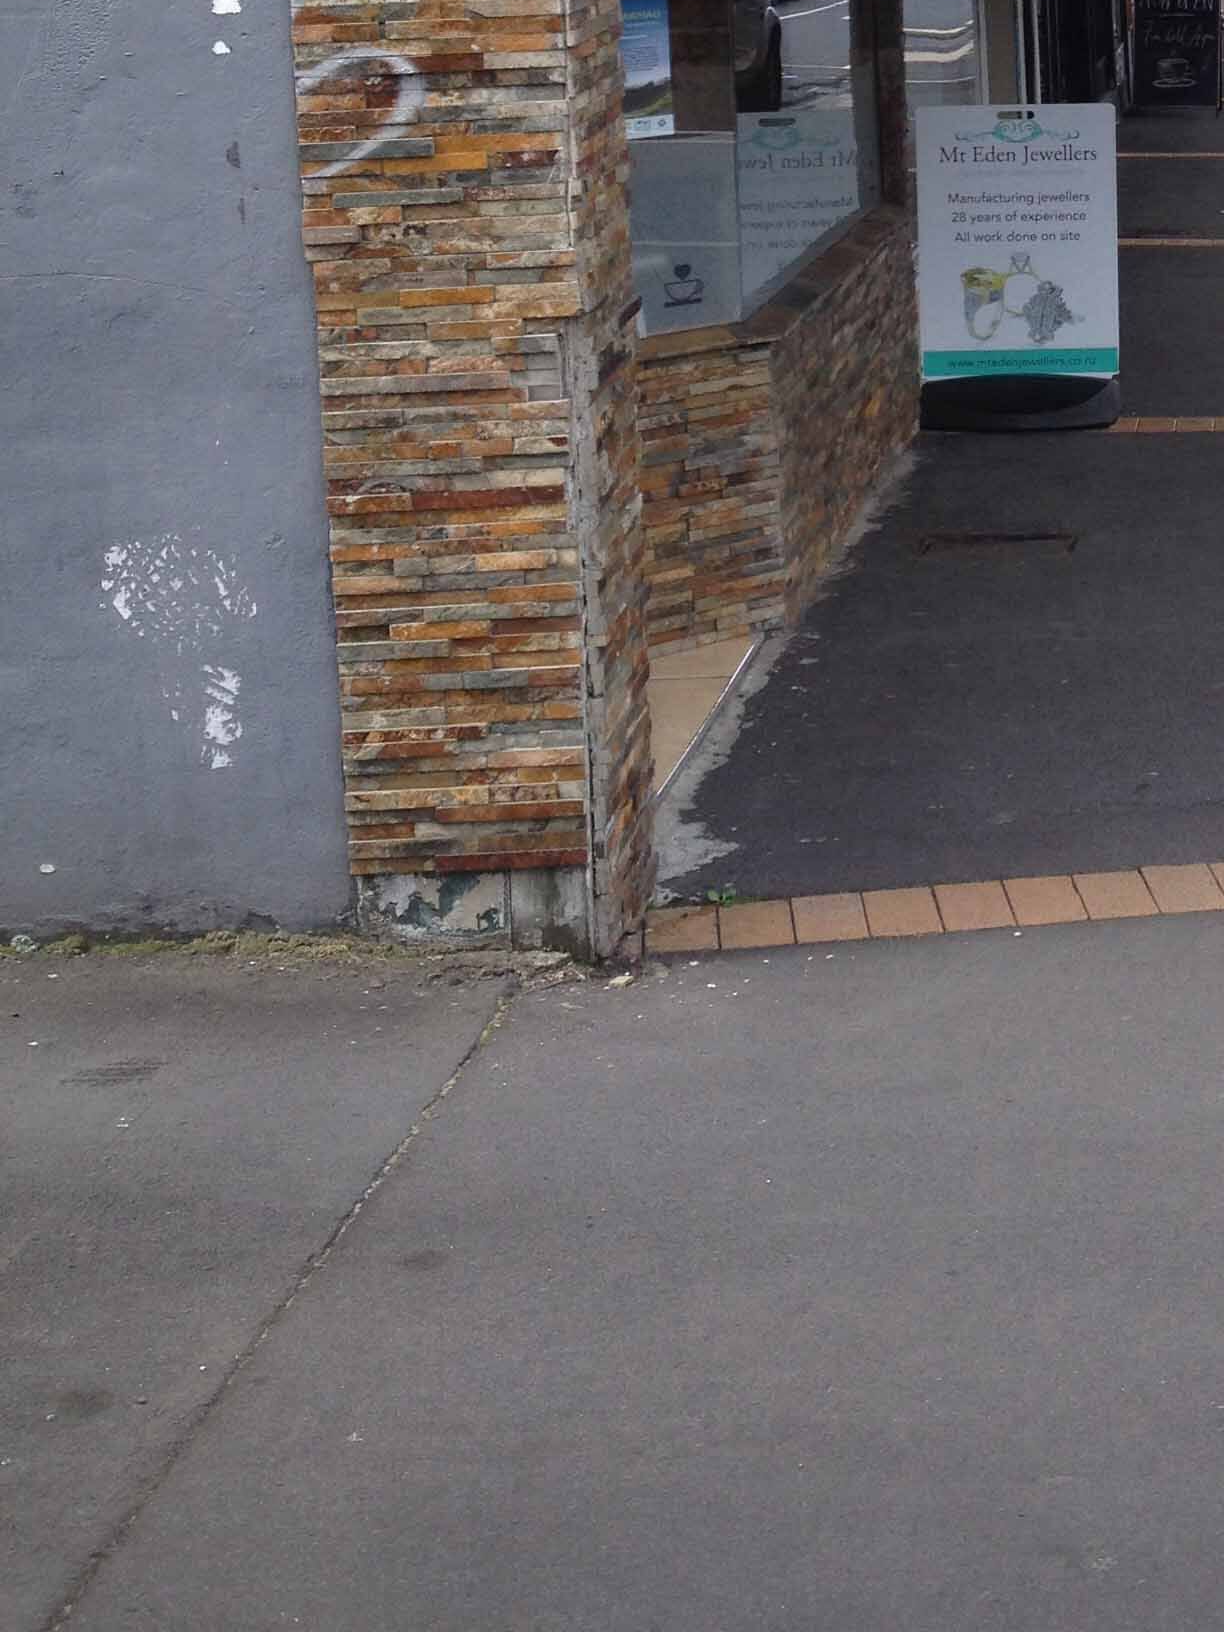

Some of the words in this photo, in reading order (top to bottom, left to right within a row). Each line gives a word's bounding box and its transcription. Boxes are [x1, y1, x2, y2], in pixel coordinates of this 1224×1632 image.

[939, 145, 967, 165] Mt
[973, 144, 1016, 164] Eden
[1021, 143, 1098, 166] Jewellers
[947, 191, 1034, 205] Manufacturing
[1037, 191, 1091, 205] jewellers
[951, 211, 967, 223] 28
[970, 212, 1002, 225] years
[1004, 210, 1018, 223] of
[1020, 210, 1087, 225] experience
[954, 230, 970, 242] All
[973, 230, 1002, 242] work
[1006, 230, 1038, 242] done
[1041, 231, 1057, 241] on
[1059, 230, 1082, 241] site
